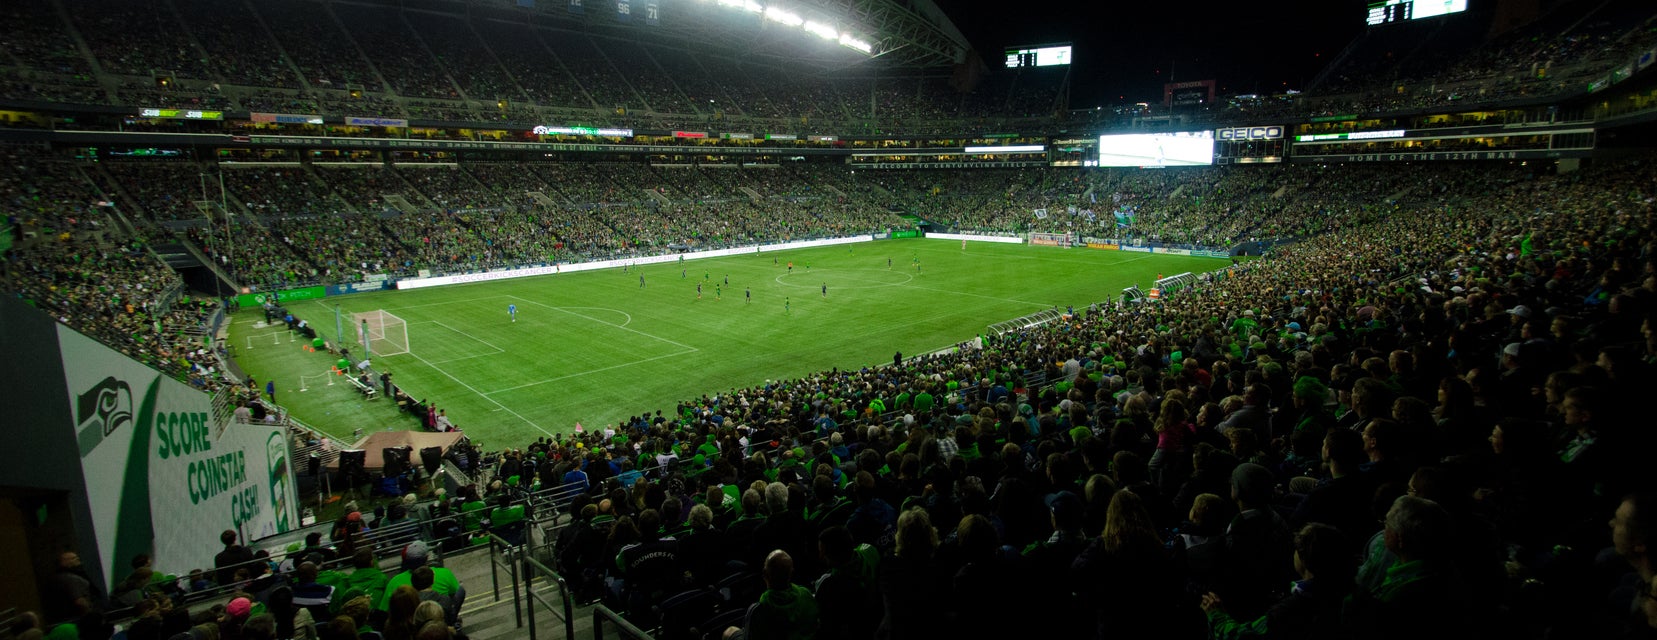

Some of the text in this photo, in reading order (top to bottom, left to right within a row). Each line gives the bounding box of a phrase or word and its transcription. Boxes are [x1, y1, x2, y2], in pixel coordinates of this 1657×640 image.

[617, 3, 630, 15] 96
[648, 7, 658, 20] 71
[1177, 81, 1201, 89] TOYOTA
[141, 109, 180, 117] SUBWAY
[185, 110, 221, 118] SUBWAY
[1219, 126, 1282, 140] GEICO
[1349, 154, 1382, 162] HOME
[1445, 152, 1478, 160] 12TH
[1487, 151, 1516, 159] MAN
[452, 266, 552, 283] #SOCCERKICKSCANCER
[156, 411, 212, 460] SCORE
[187, 450, 247, 505] COINSTAR
[231, 484, 260, 530] CASH!
[631, 552, 666, 568] SOUNDERS
